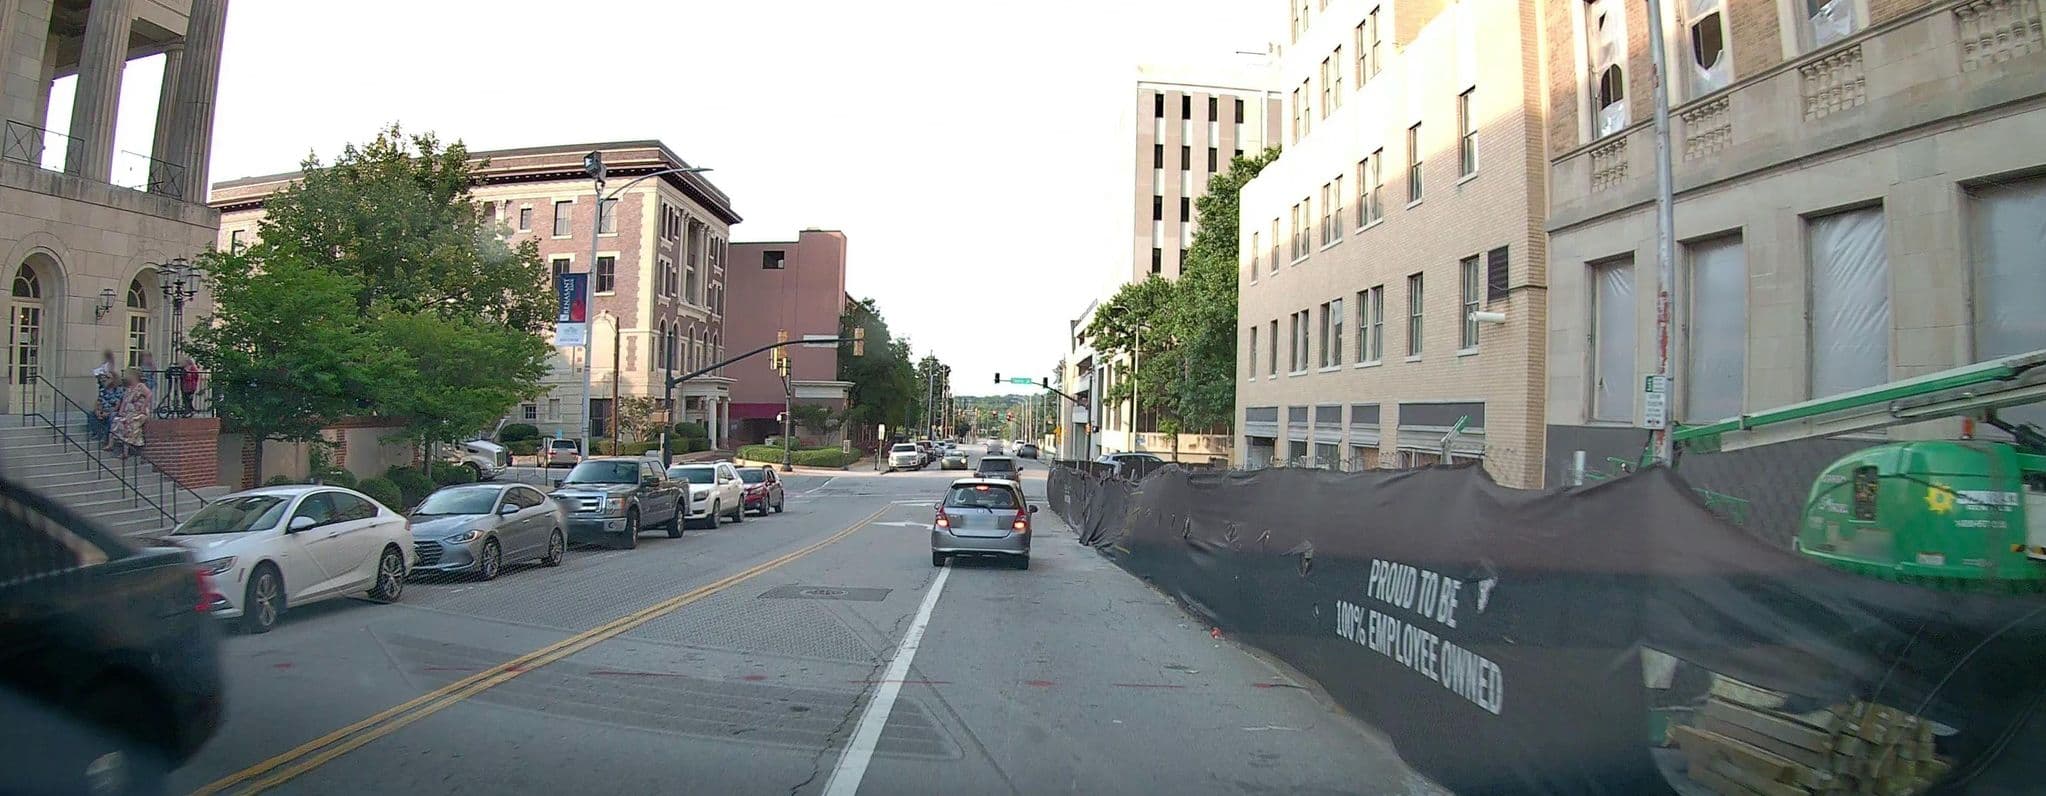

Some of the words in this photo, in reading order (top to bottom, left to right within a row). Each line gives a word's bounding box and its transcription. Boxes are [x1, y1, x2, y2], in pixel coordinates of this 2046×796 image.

[1367, 559, 1417, 609] PROUD
[1417, 570, 1438, 618] TO
[1437, 576, 1462, 629] BE
[1336, 600, 1367, 646] 100%
[1368, 610, 1439, 682] EMPLOYEE
[1440, 640, 1503, 715] OWNED
